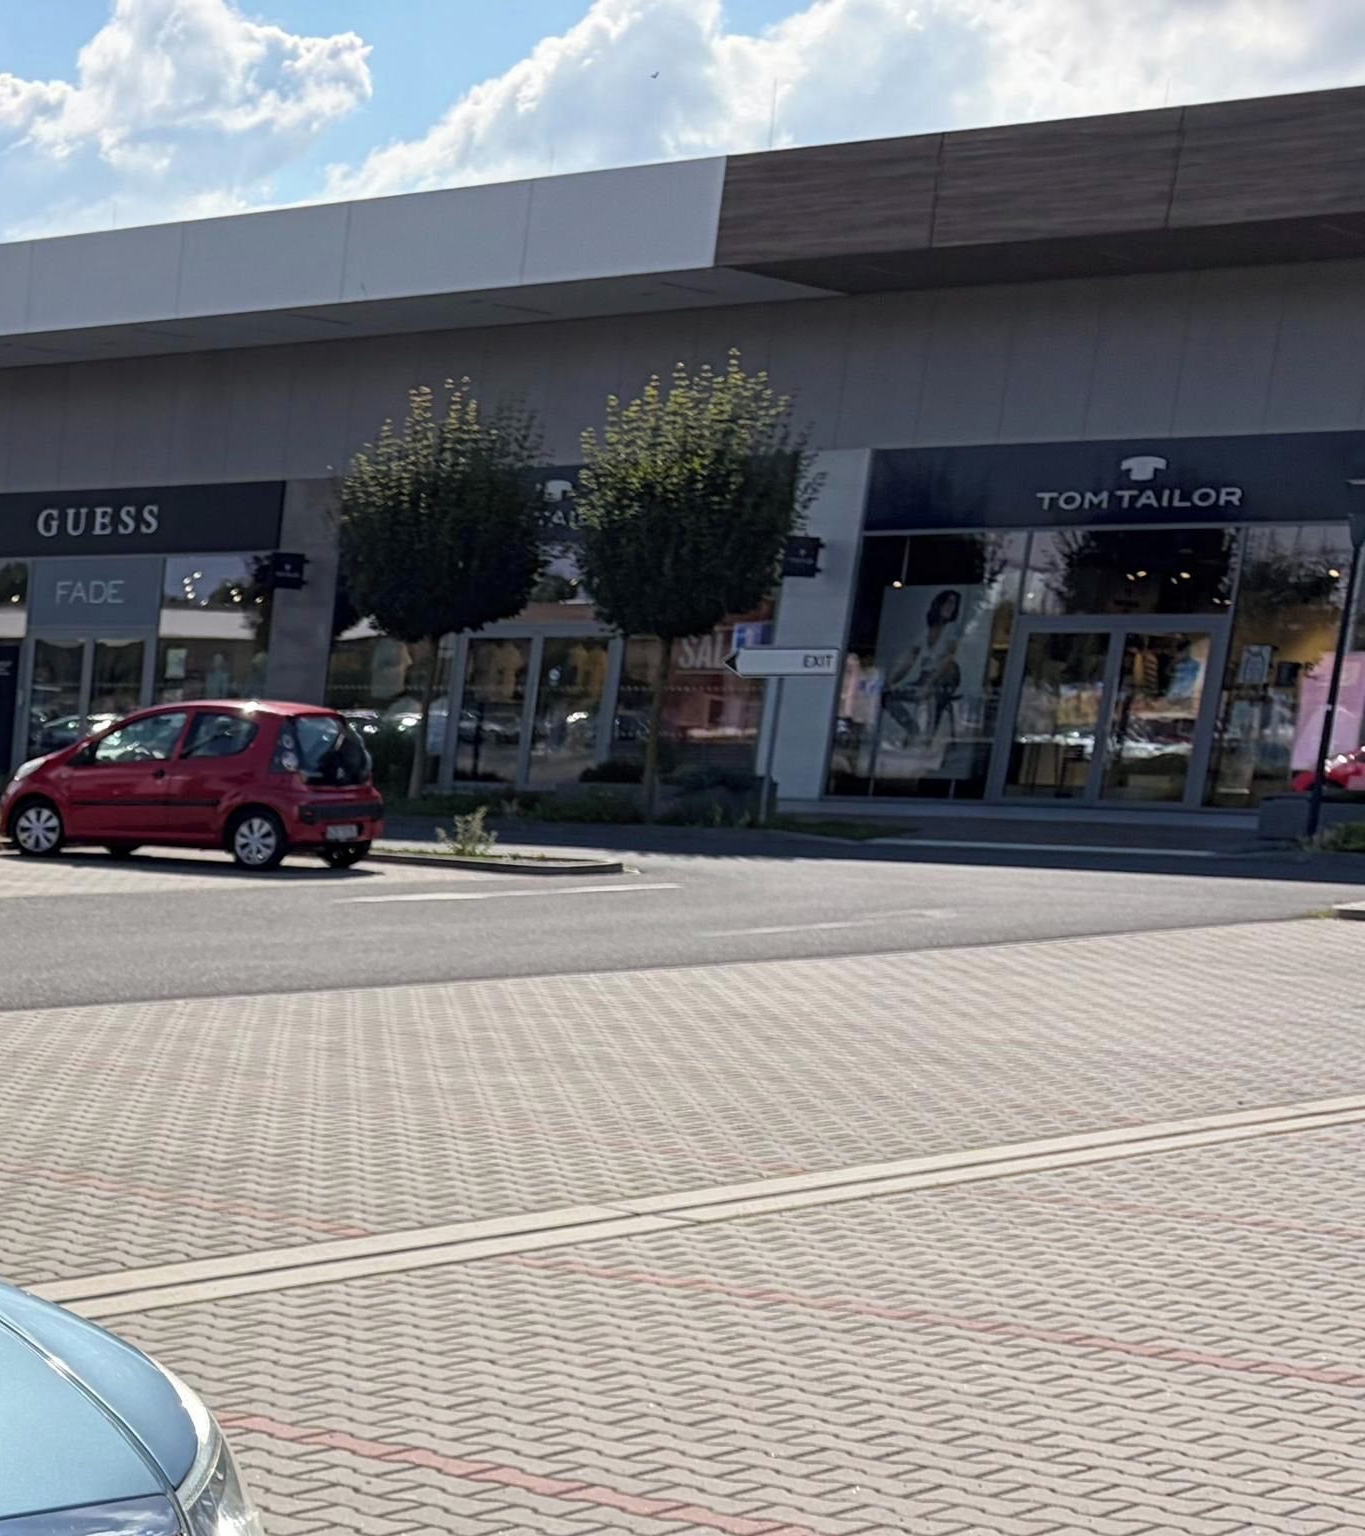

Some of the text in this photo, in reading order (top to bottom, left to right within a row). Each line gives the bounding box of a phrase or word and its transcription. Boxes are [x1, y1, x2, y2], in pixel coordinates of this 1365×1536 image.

[1036, 487, 1243, 510] TOM TAILOR
[37, 504, 159, 537] GUESS
[55, 580, 125, 604] FADE
[803, 654, 834, 668] EXIT
